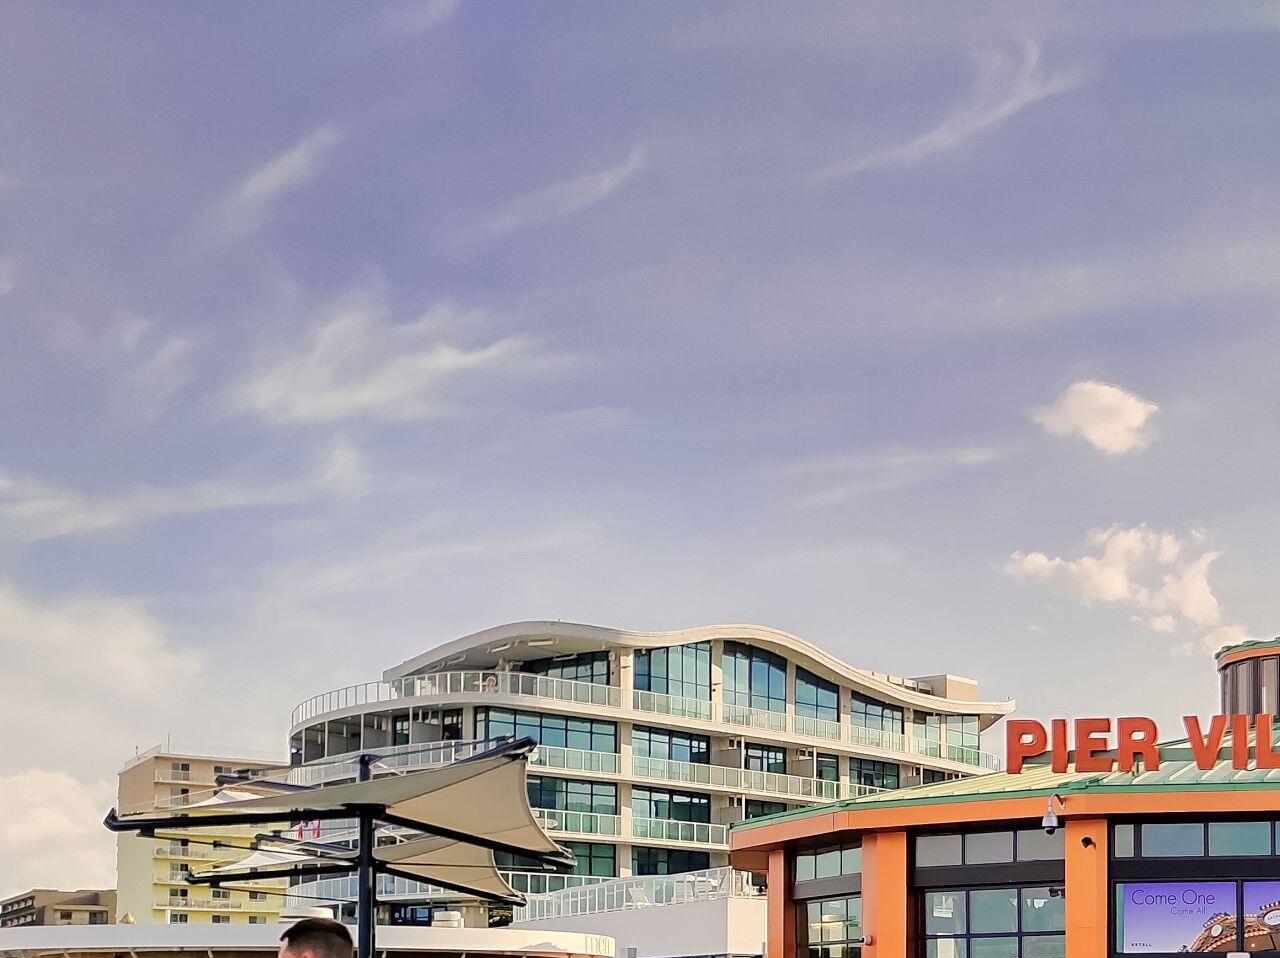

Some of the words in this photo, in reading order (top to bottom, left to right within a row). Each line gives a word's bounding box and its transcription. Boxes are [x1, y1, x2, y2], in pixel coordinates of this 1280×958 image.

[1005, 716, 1160, 774] PIER
[1131, 889, 1177, 905] Come
[1181, 889, 1216, 905] One
[1170, 907, 1194, 915] Come
[1196, 906, 1206, 914] All
